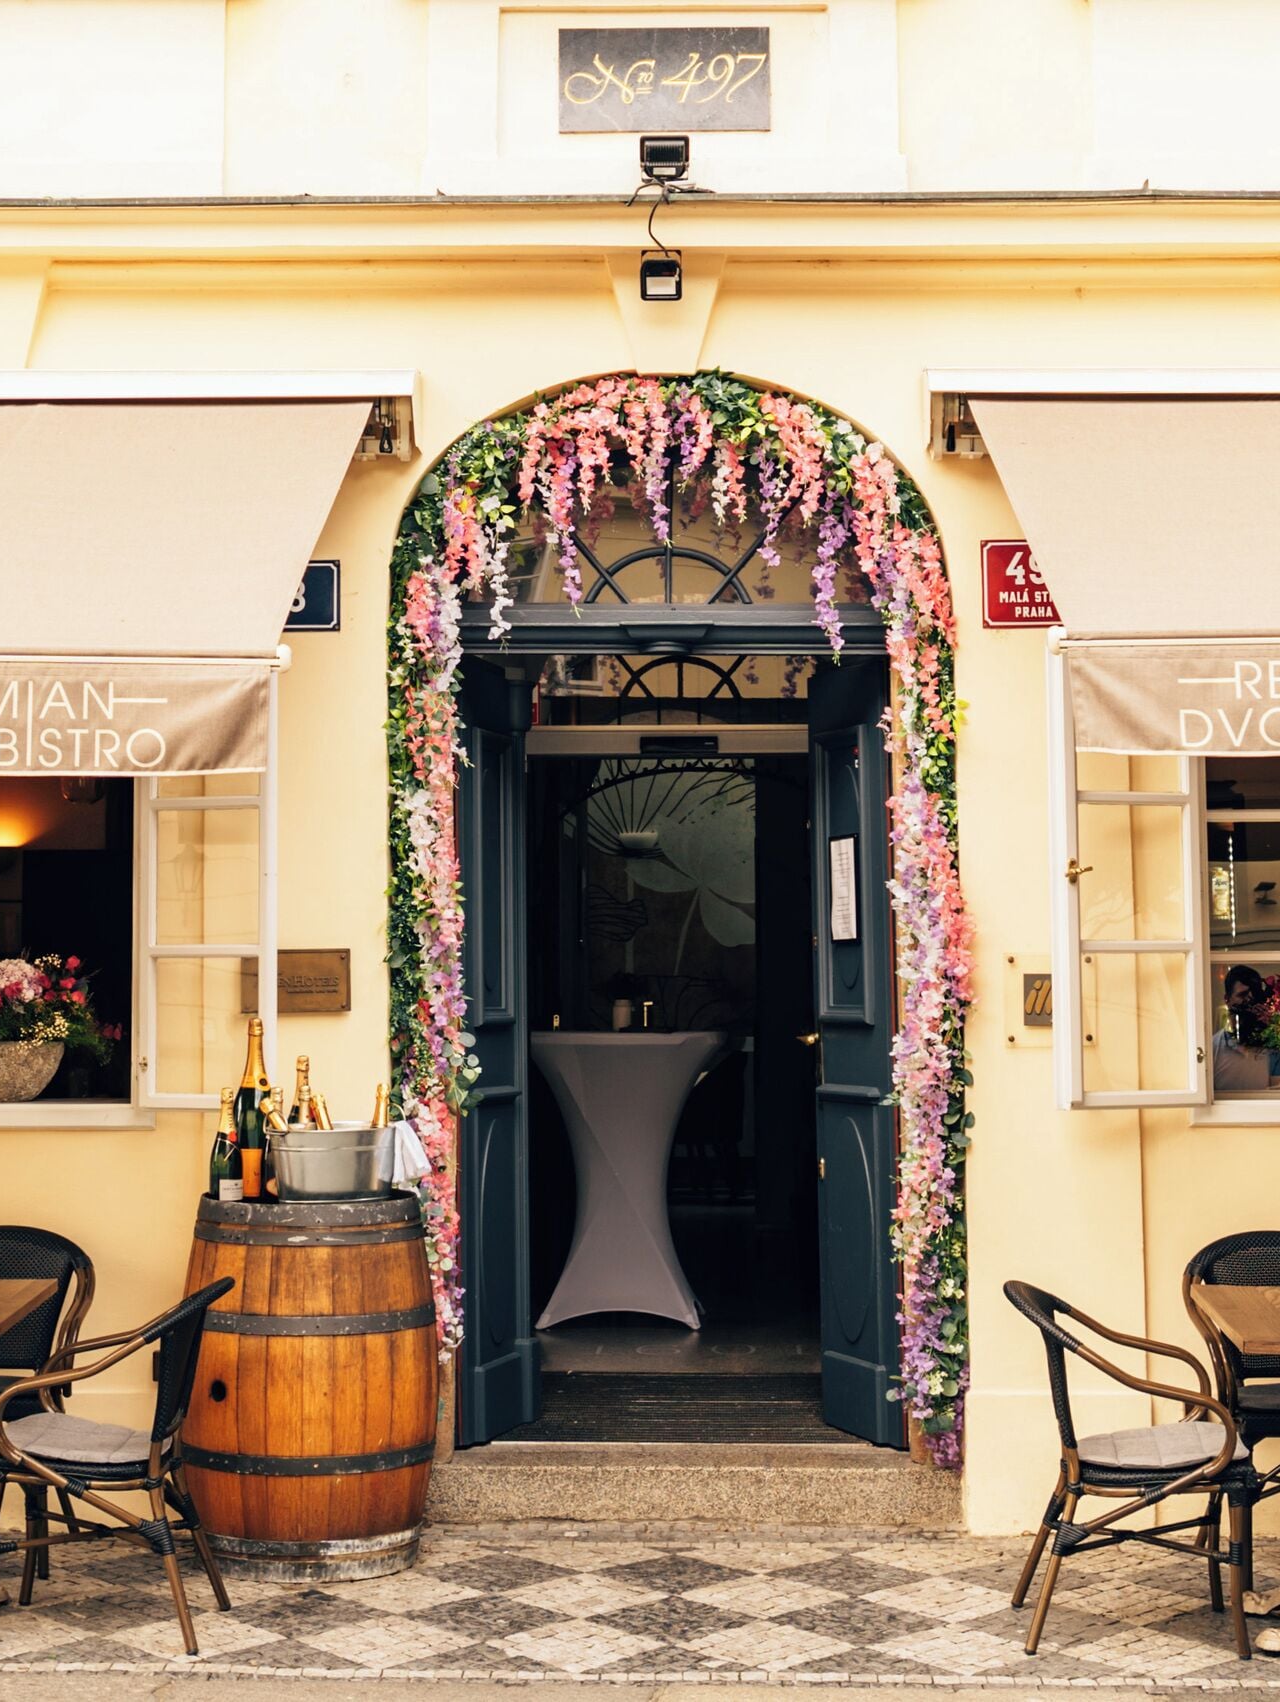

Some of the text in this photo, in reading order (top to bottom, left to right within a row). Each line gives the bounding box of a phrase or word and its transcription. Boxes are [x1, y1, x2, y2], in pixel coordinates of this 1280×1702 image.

[661, 52, 767, 104] 497
[999, 588, 1030, 603] MALÁ
[1015, 606, 1054, 618] PRAHA
